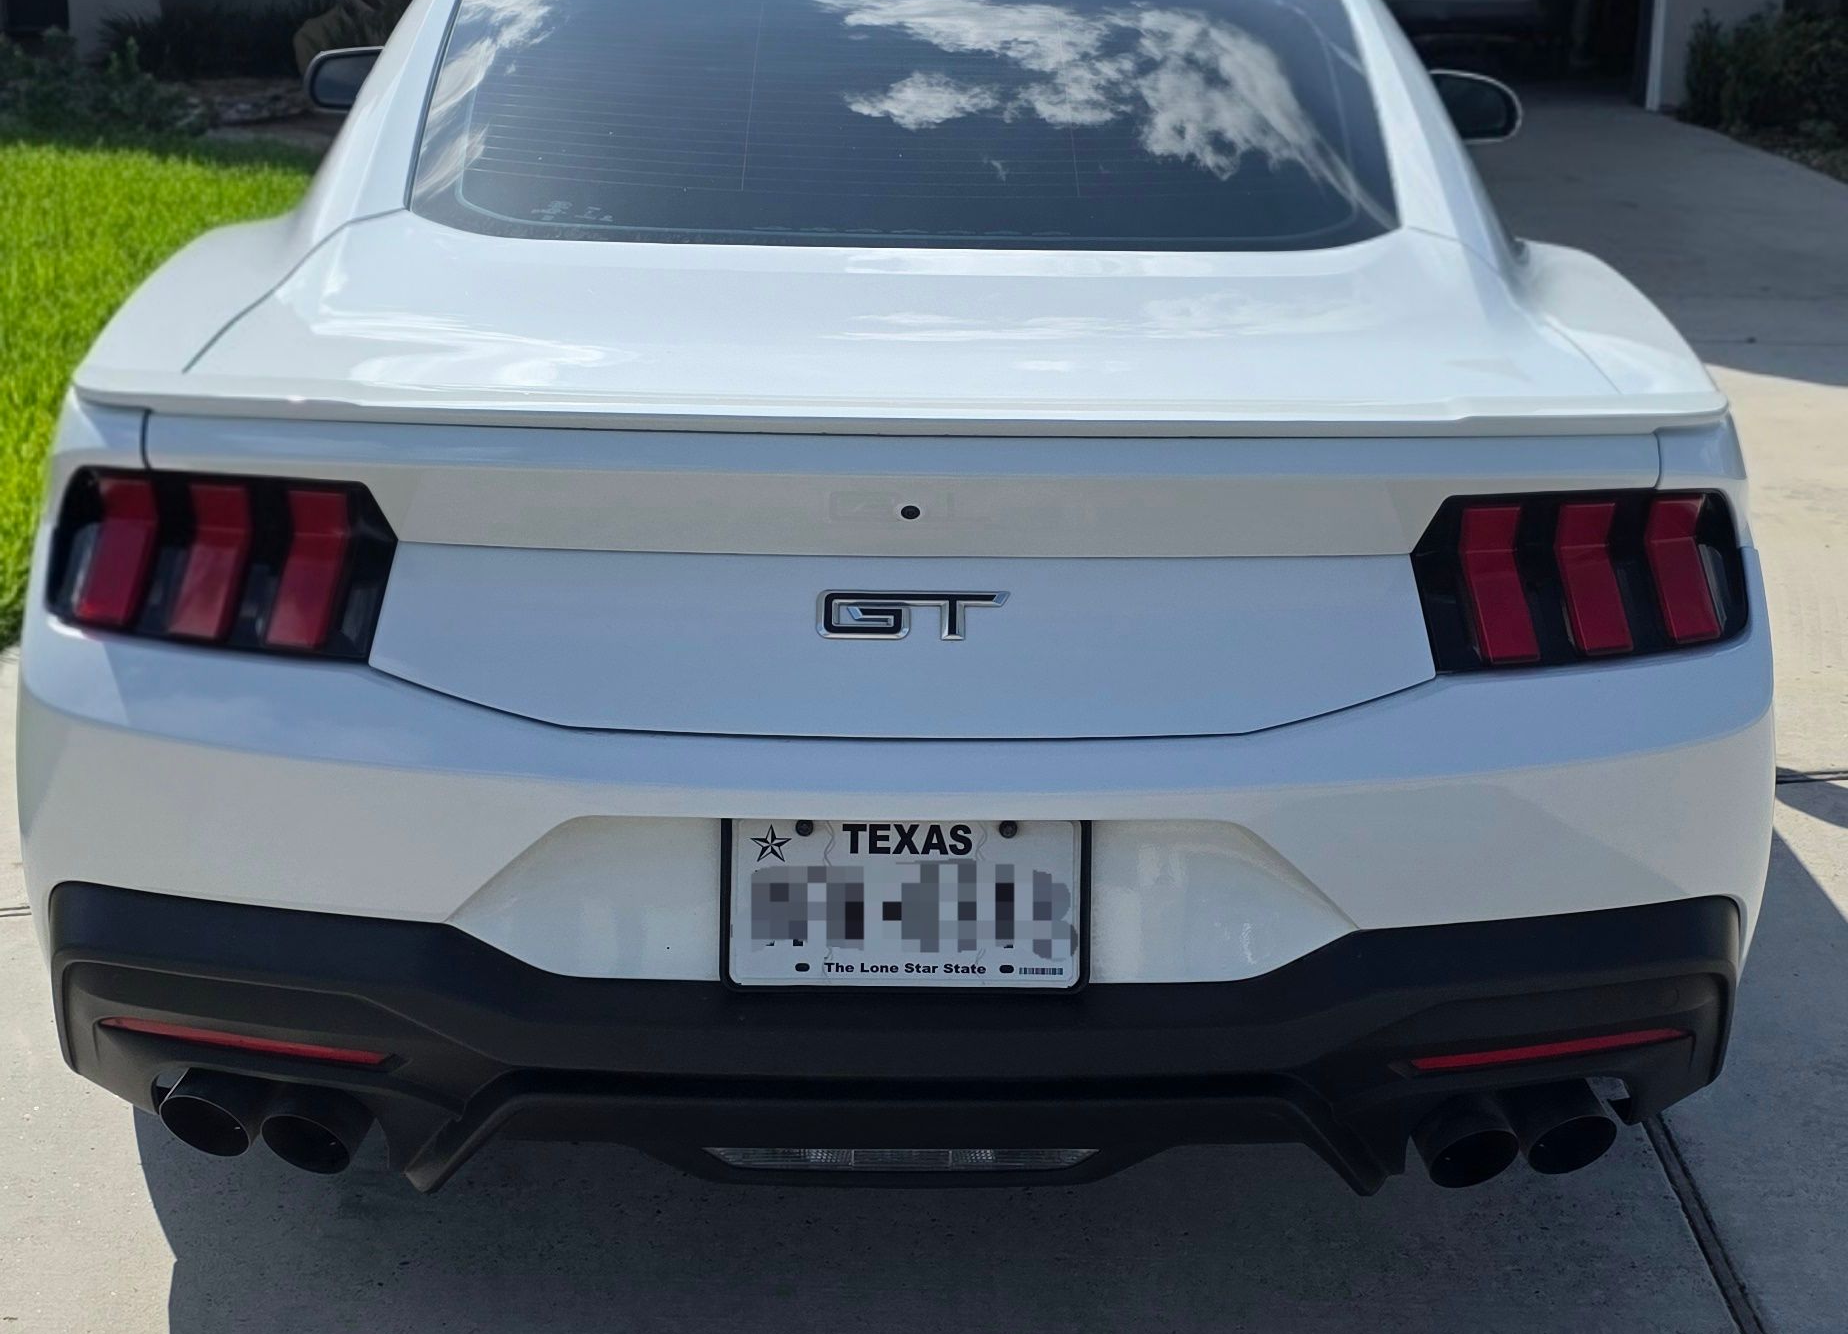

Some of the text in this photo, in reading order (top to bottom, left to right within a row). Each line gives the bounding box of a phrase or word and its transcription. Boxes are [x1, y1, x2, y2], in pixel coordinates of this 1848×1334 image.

[816, 589, 1011, 640] GT
[842, 823, 973, 856] TEXAS
[824, 962, 987, 975] The Lone Star State
